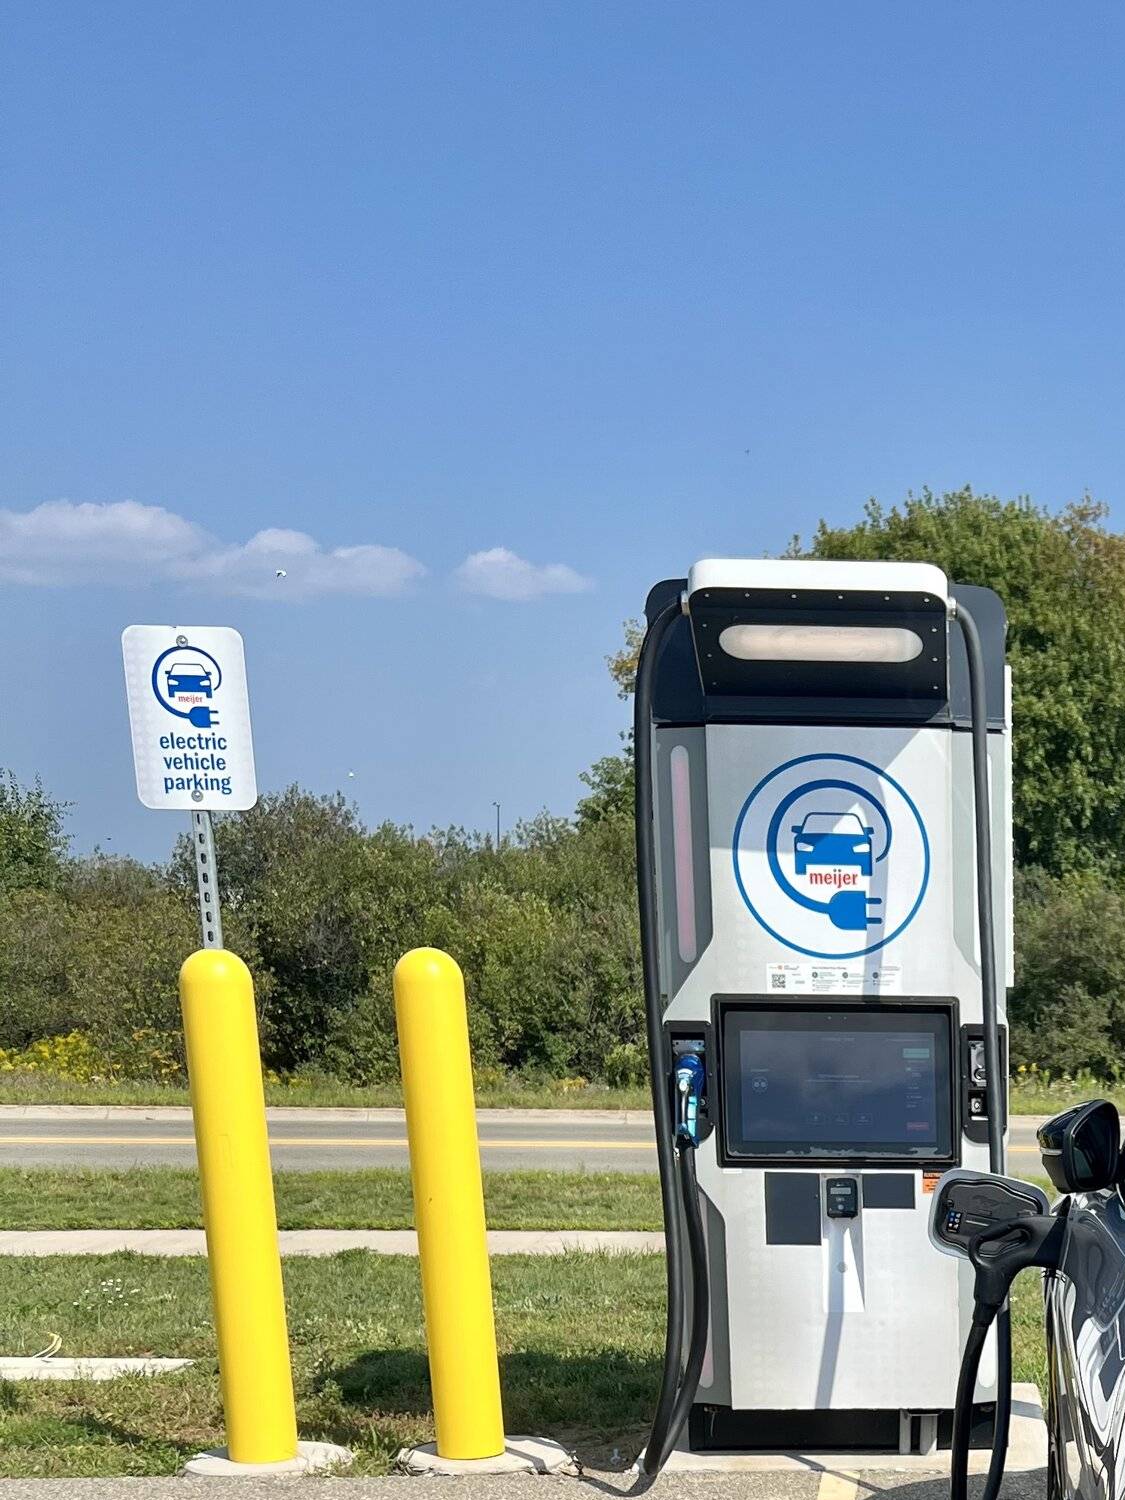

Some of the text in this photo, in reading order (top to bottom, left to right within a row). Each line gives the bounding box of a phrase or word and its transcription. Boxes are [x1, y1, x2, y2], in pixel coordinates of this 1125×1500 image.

[159, 732, 227, 750] electric
[164, 753, 226, 770] vehicle
[164, 773, 232, 795] parking
[809, 869, 858, 889] meijer
